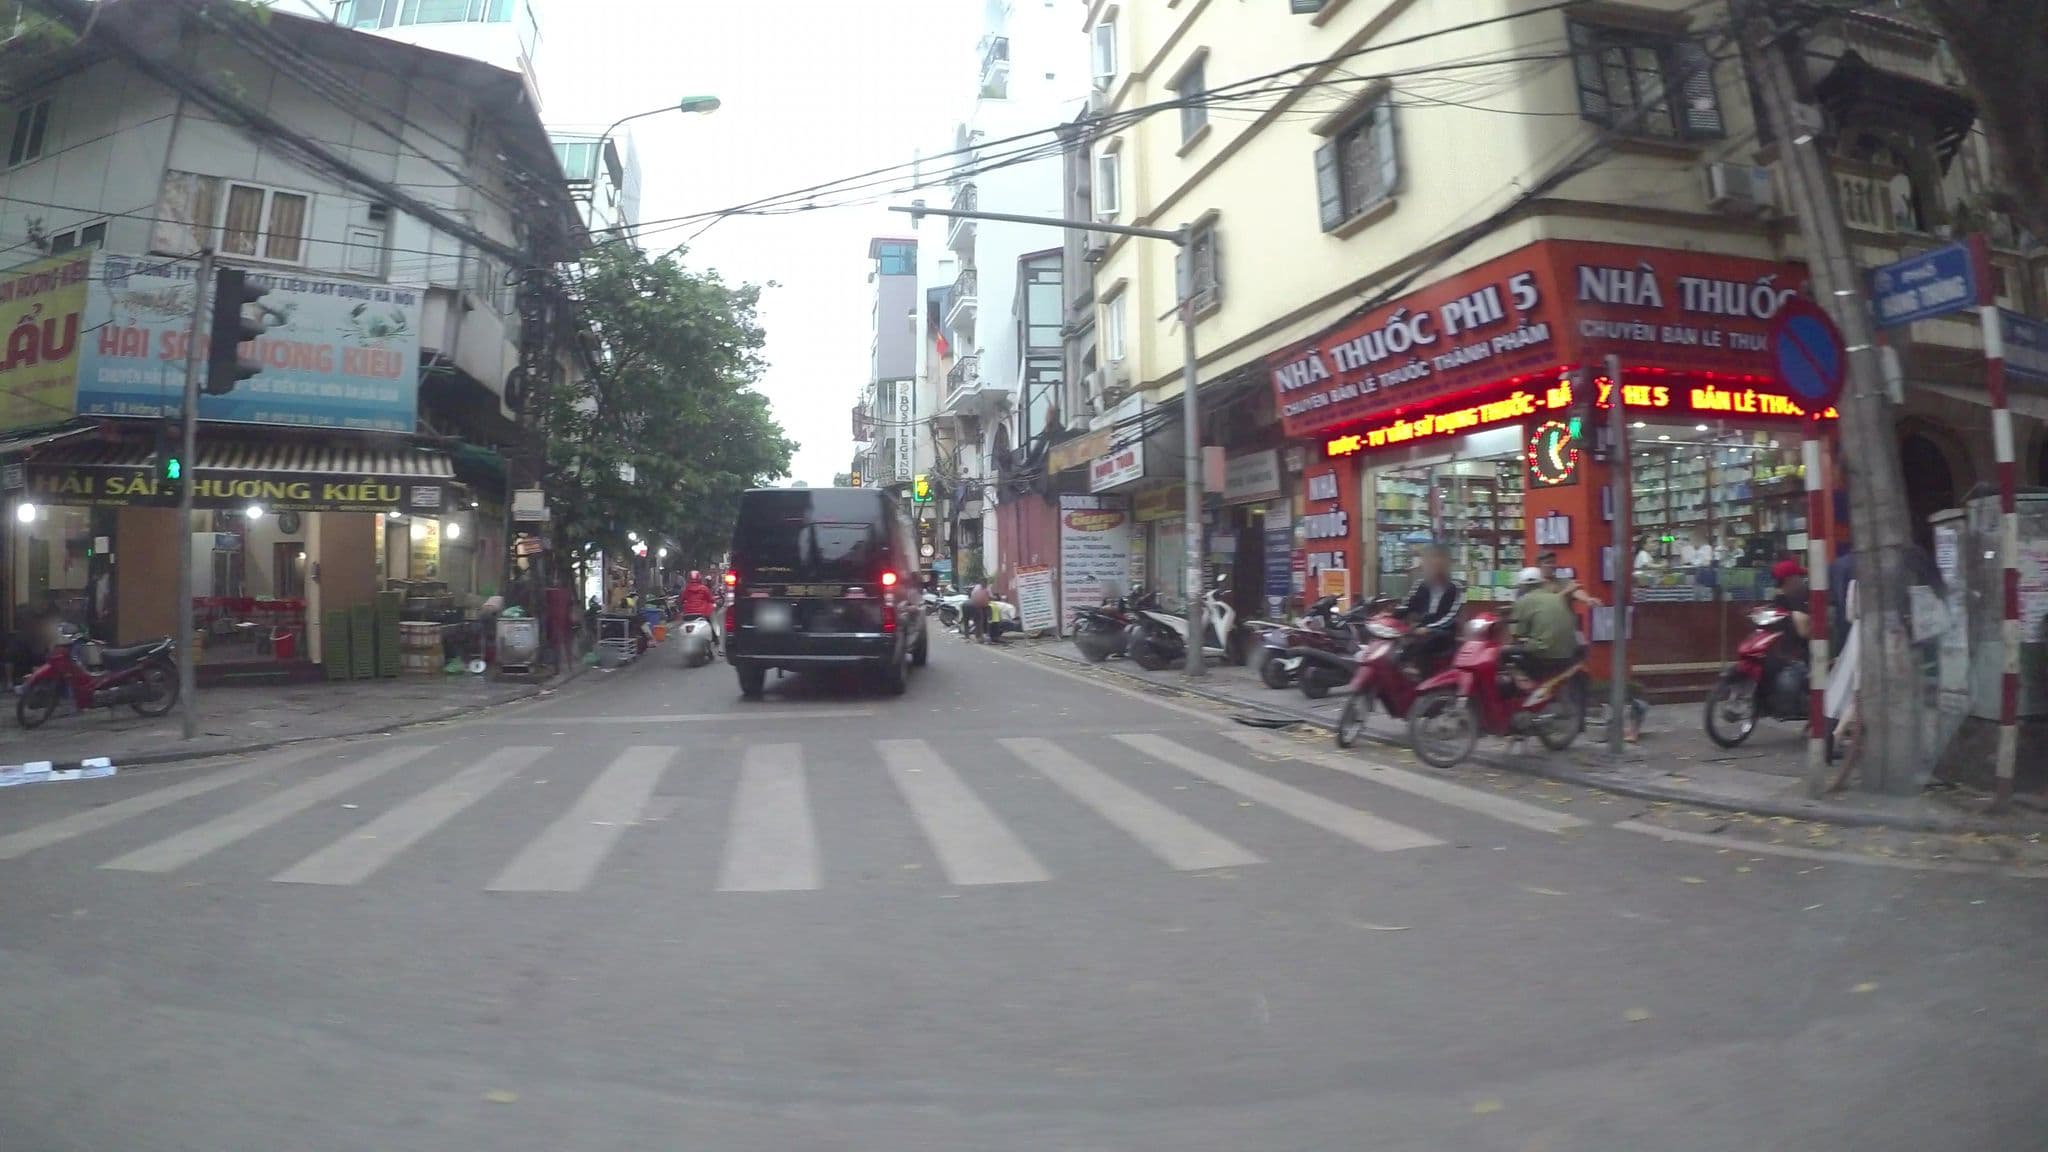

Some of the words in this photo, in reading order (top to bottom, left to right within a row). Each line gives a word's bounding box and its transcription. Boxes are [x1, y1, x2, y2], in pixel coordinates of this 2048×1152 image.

[1577, 262, 1664, 308] NHÀ
[98, 318, 149, 359] HẢI
[1275, 348, 1330, 393] NHÀ
[1329, 308, 1436, 372] THUỐC
[1441, 286, 1504, 336] PHI
[1508, 273, 1537, 310] 5
[1579, 320, 1656, 341] CHUYÊN
[1728, 332, 1768, 351] THU
[1283, 392, 1330, 416] CHUYÊN
[1378, 357, 1430, 387] THUỐC
[1432, 347, 1491, 370] THÀNH
[1492, 318, 1549, 352] PHẨM
[1478, 391, 1535, 423] THUỐC
[1653, 386, 1670, 407] 5
[1691, 384, 1731, 410] BÁN
[35, 471, 94, 494] HẢI
[191, 479, 311, 500] HƯƠNG
